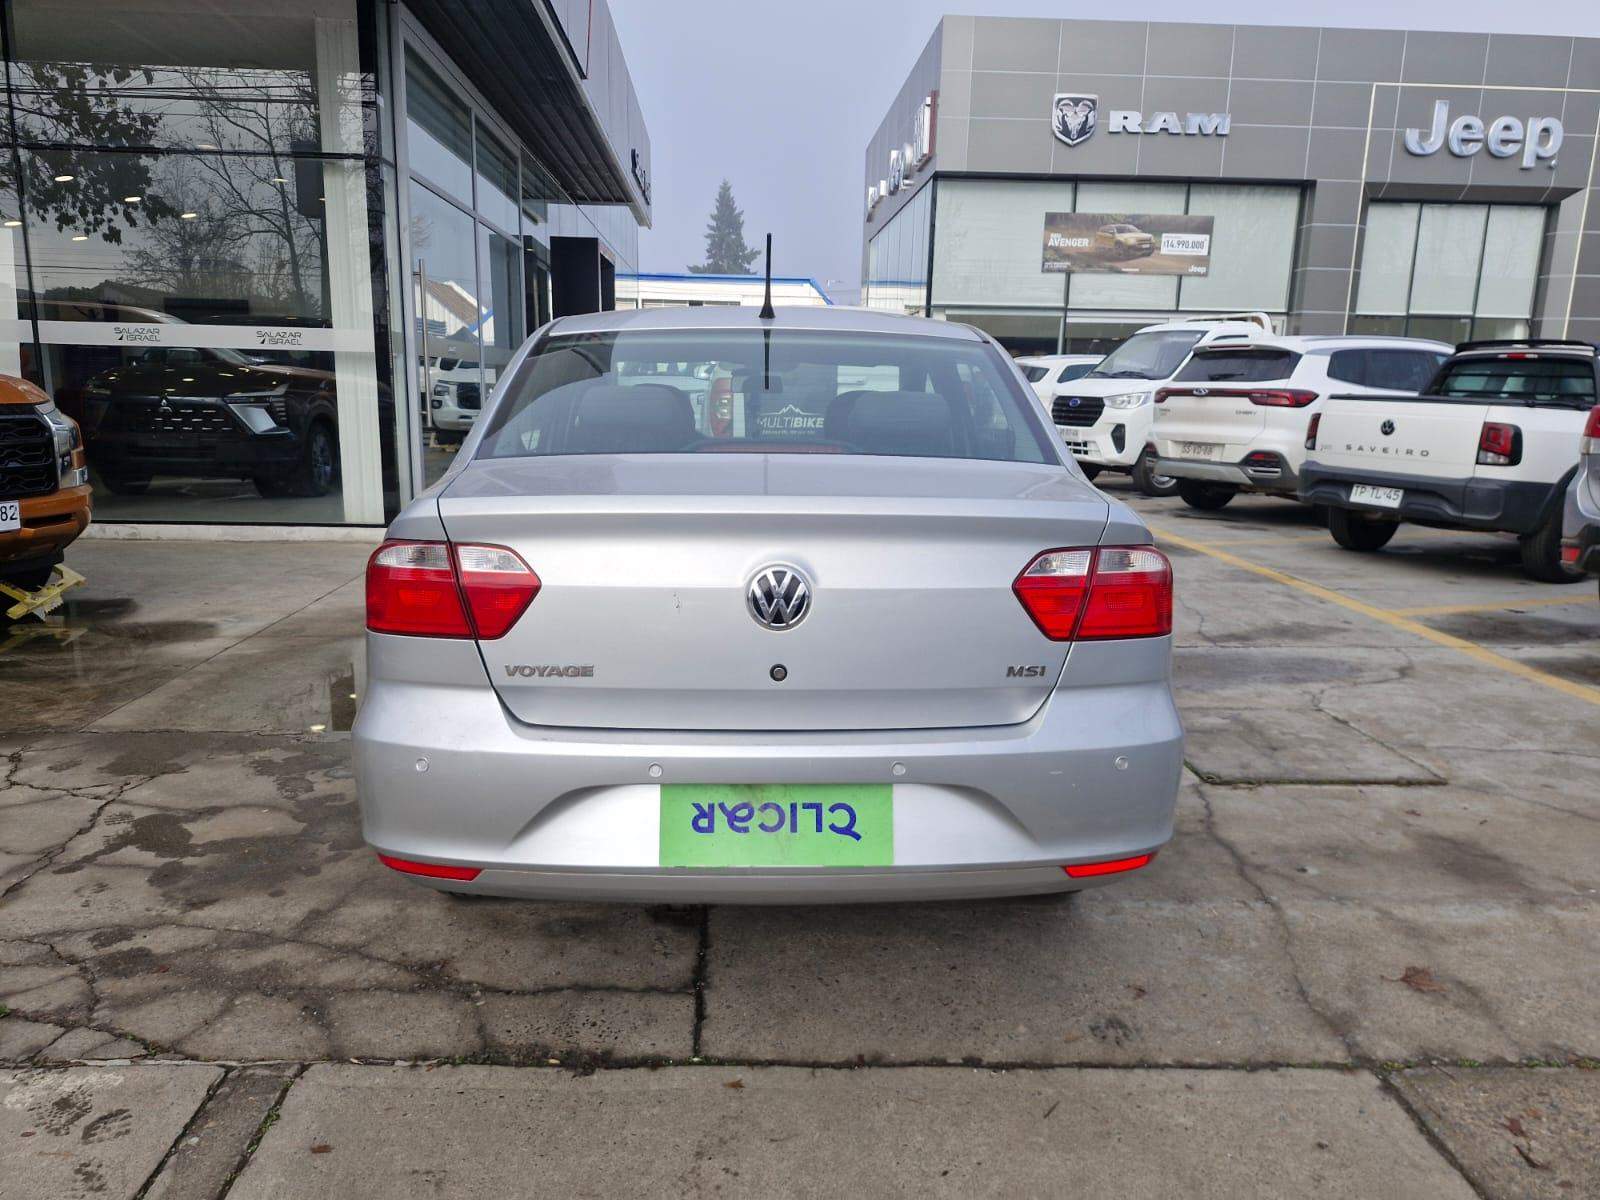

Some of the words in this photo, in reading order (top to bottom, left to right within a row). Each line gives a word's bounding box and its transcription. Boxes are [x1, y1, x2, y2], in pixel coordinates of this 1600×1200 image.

[1108, 110, 1231, 136] RAM
[1404, 99, 1564, 170] Jeep
[1048, 237, 1089, 248] AVENGER
[113, 326, 161, 335] SALAZAR
[256, 330, 303, 338] SALAZAR
[126, 334, 161, 342] ISRAEL
[268, 337, 303, 346] ISRAEL
[757, 416, 825, 429] MULTIBIKE
[1345, 443, 1431, 458] SAVEIRO
[504, 664, 595, 678] VOYAGE
[1005, 665, 1047, 678] MSI
